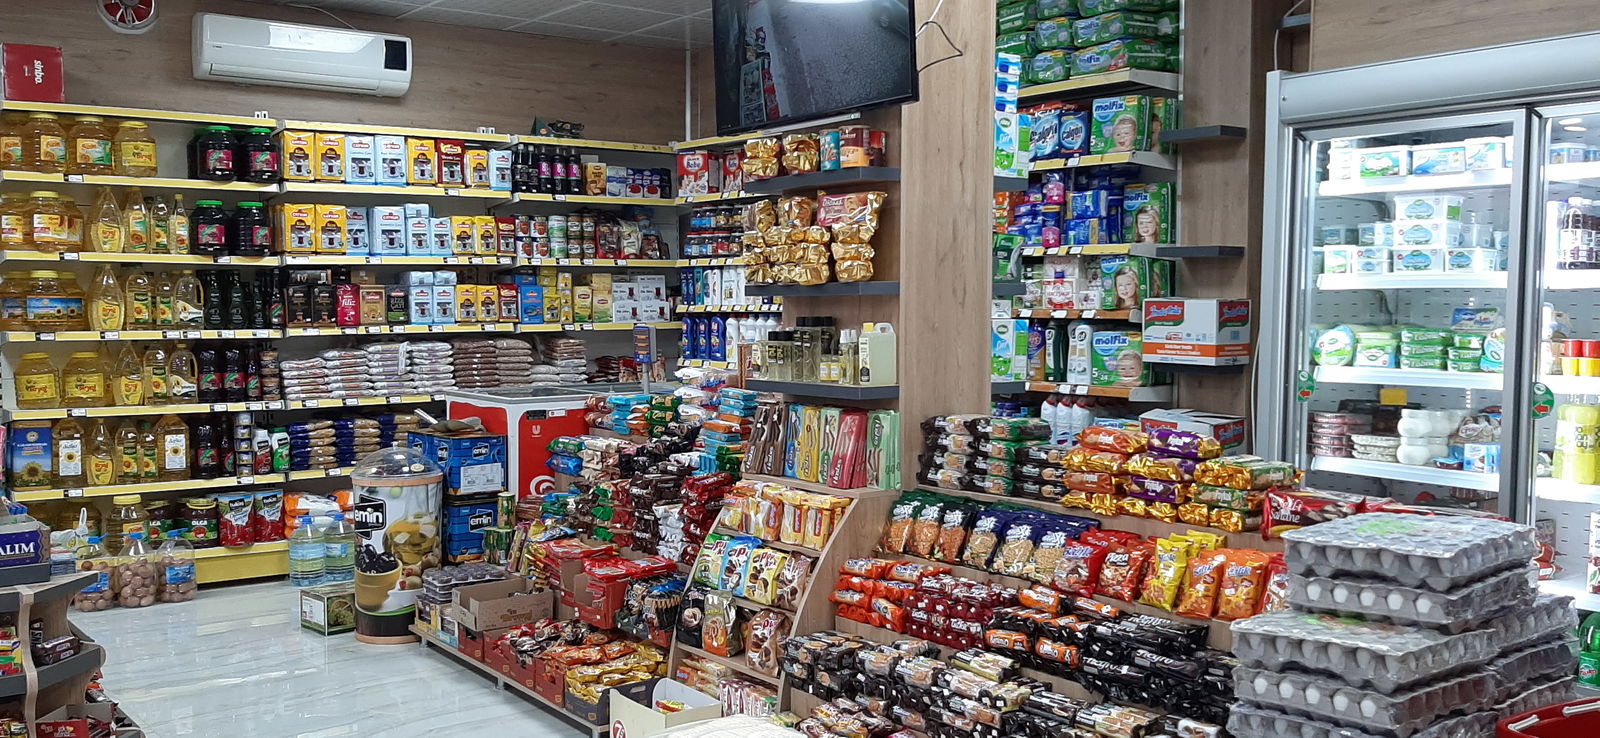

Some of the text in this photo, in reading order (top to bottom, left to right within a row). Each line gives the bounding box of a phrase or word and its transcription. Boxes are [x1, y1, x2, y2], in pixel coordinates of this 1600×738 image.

[1095, 101, 1124, 112] molfix
[1062, 125, 1083, 141] Calgon
[1090, 135, 1096, 146] 5
[1094, 335, 1128, 346] molfix
[1092, 367, 1099, 378] 5
[473, 446, 489, 454] emin
[354, 508, 383, 524] emin
[470, 515, 492, 526] emin
[0, 541, 36, 556] ALIM
[1105, 552, 1129, 563] Pizza
[1136, 649, 1174, 664] negro
